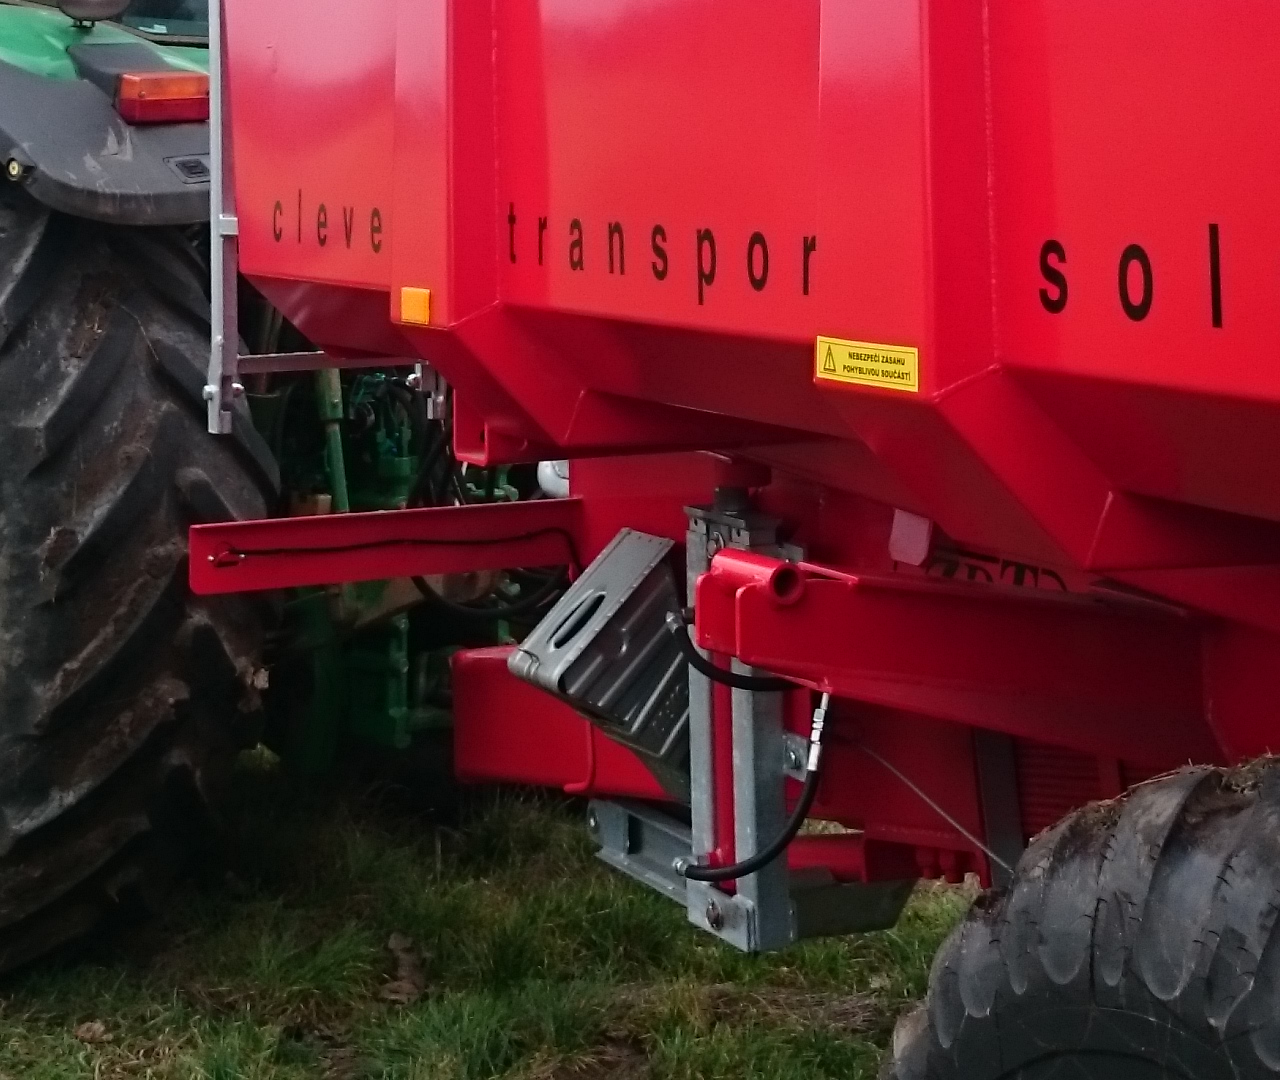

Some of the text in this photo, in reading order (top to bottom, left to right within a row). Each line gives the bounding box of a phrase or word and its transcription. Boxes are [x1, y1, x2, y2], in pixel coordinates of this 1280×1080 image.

[272, 189, 384, 254] cleve
[507, 201, 817, 306] transpor
[848, 351, 905, 366] NEBEZPEČÍ ZÁSAHU
